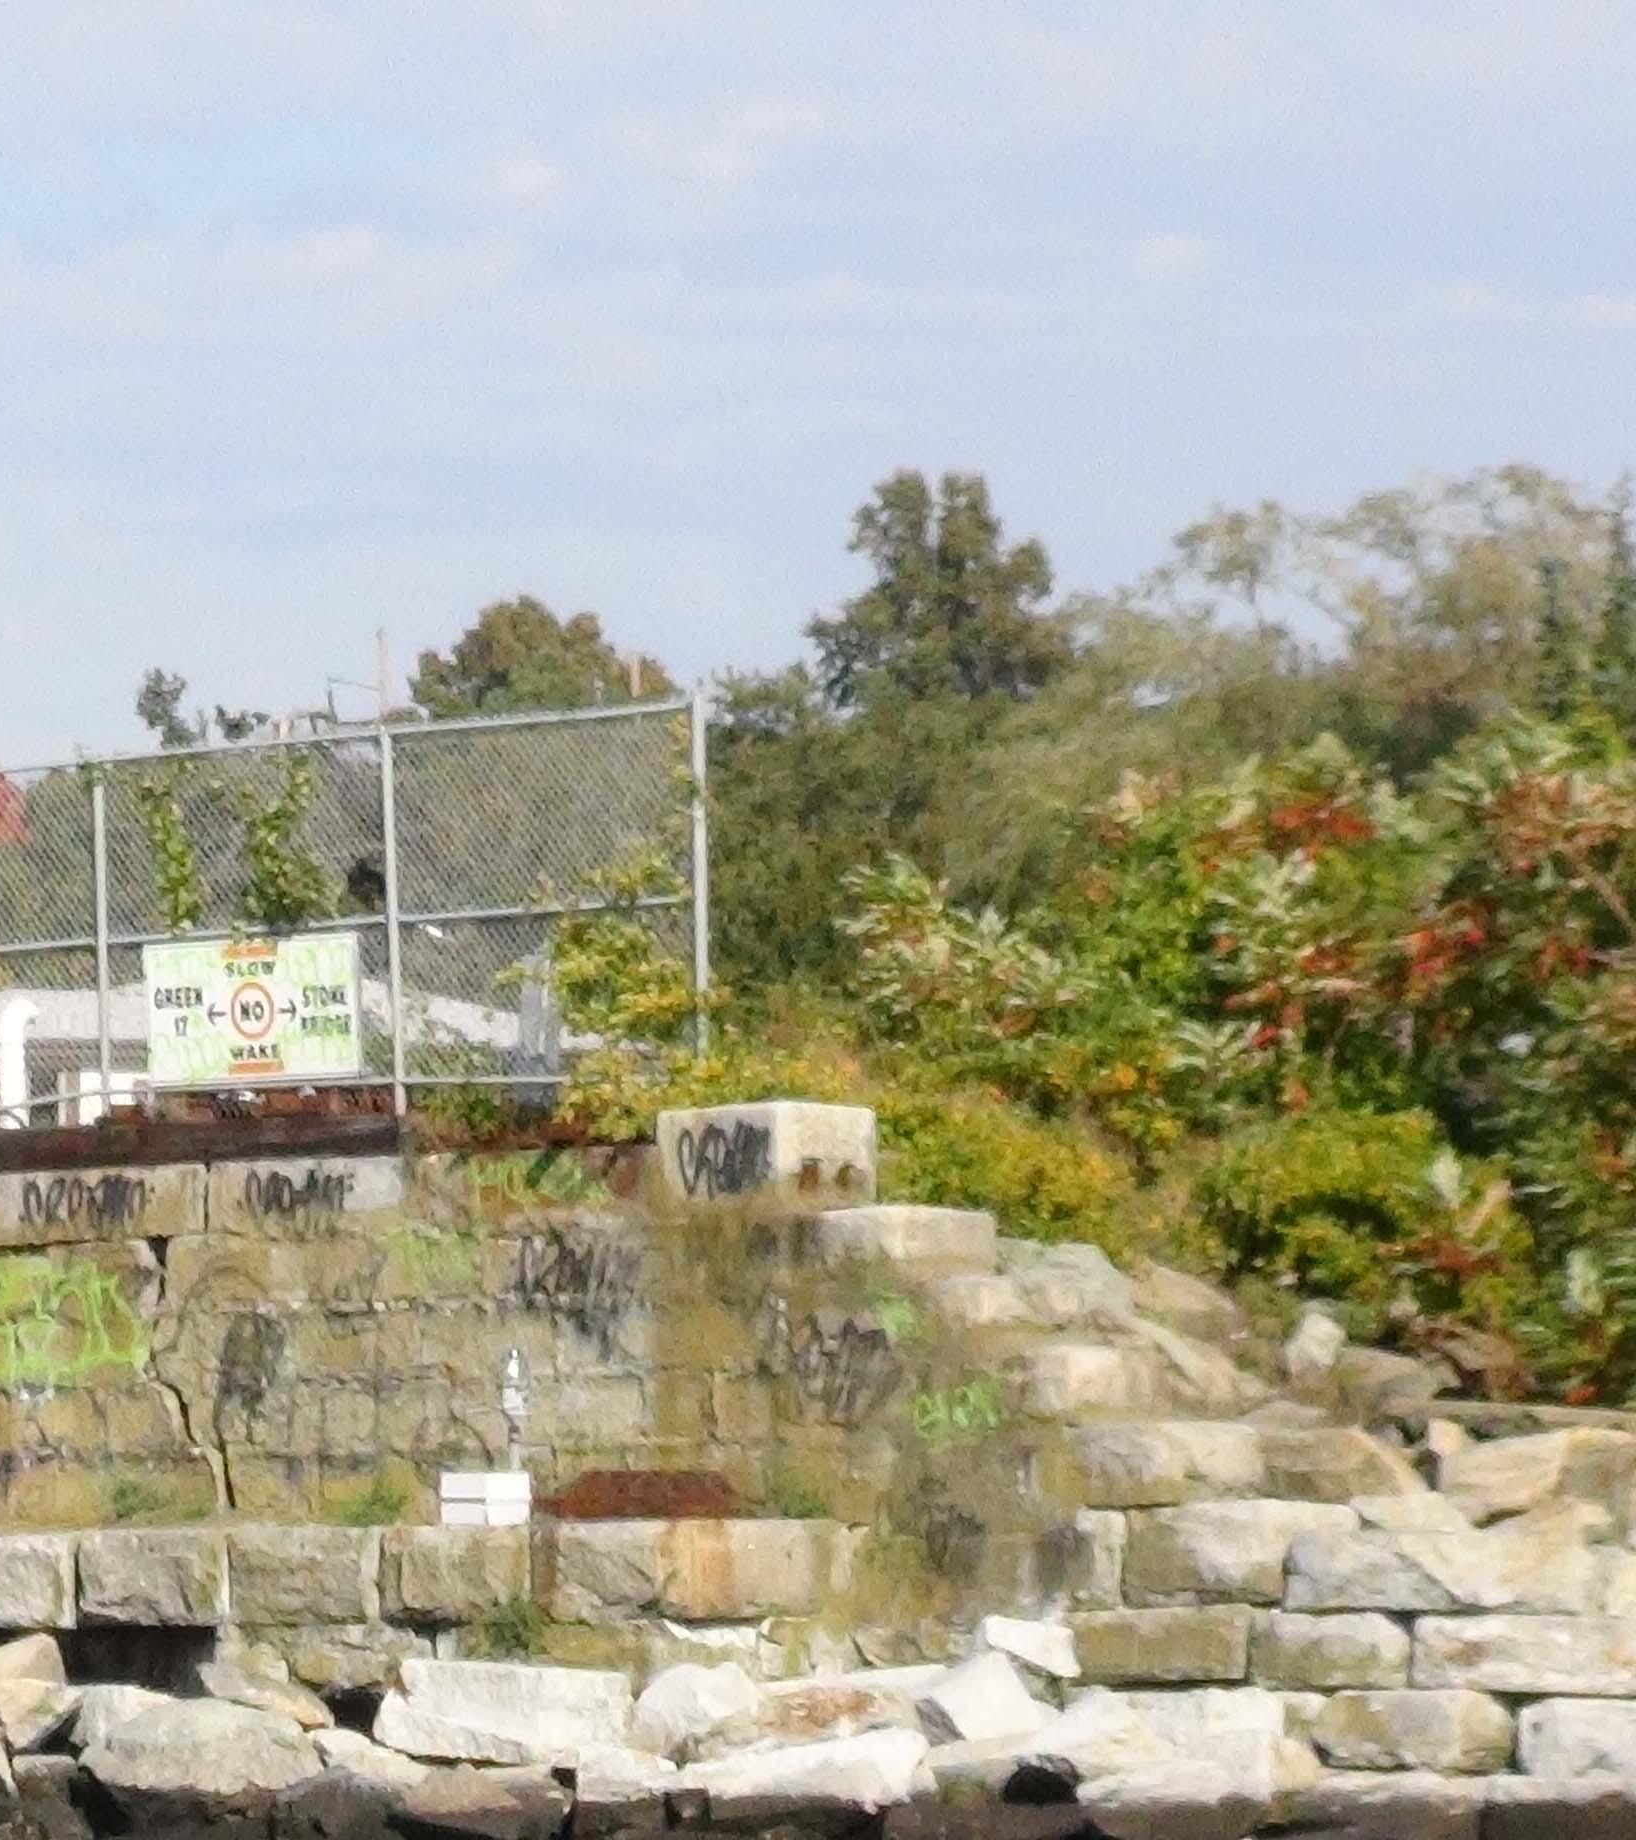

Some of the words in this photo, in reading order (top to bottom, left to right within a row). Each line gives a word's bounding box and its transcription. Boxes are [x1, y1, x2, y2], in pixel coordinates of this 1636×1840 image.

[223, 961, 276, 977] SLOW
[239, 1000, 264, 1021] NO
[230, 1043, 280, 1060] WAKE
